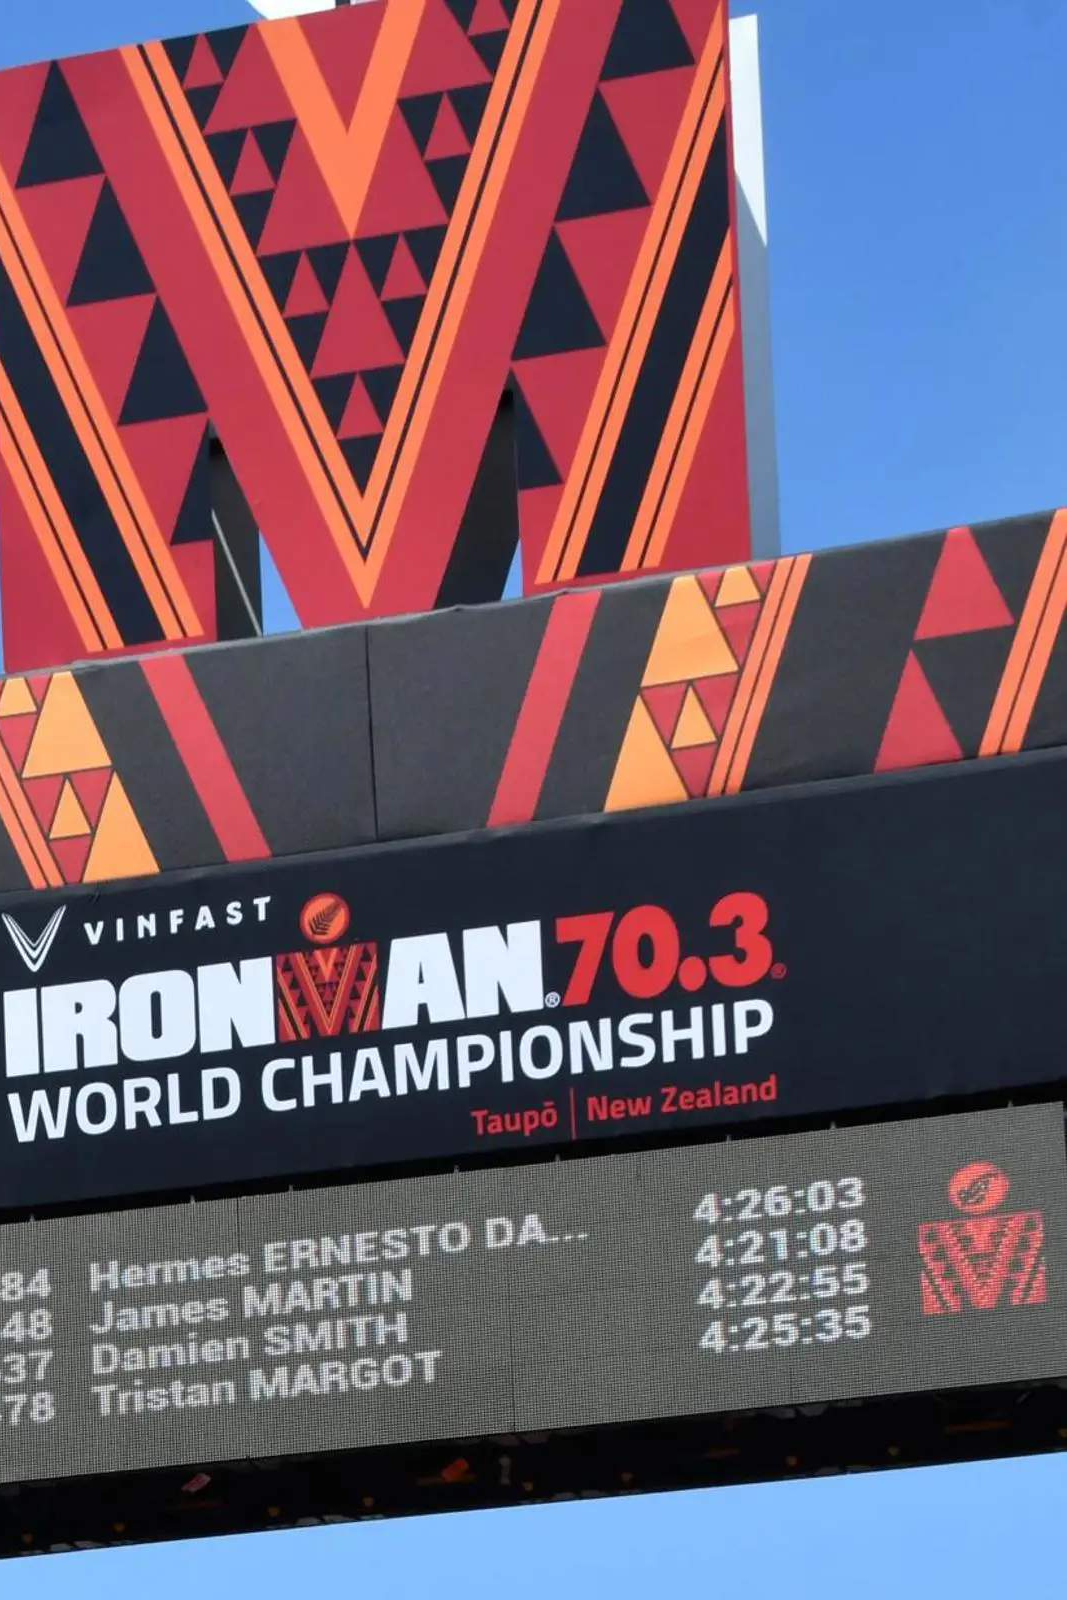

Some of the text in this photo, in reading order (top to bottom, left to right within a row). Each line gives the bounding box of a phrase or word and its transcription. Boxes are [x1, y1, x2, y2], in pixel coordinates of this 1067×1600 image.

[84, 896, 273, 946] VINFAST
[555, 891, 773, 1006] 70.3
[8, 999, 775, 1143] WORLD CHAMPIONSHIP
[471, 1075, 778, 1138] Taupō New Zealand
[89, 1249, 250, 1293] Hermes
[263, 1223, 470, 1275] ERNESTO
[692, 1175, 867, 1225] 4:26:03
[89, 1289, 230, 1335] James
[243, 1268, 413, 1318] MARTIN
[694, 1219, 869, 1268] 4:21:08
[91, 1378, 237, 1418] Tristan
[250, 1350, 442, 1402] MARGOT
[698, 1304, 872, 1354] 4:25:35
[92, 1331, 250, 1376] Damien
[264, 1311, 409, 1357] SMITH
[697, 1262, 871, 1311] 4:22:55
